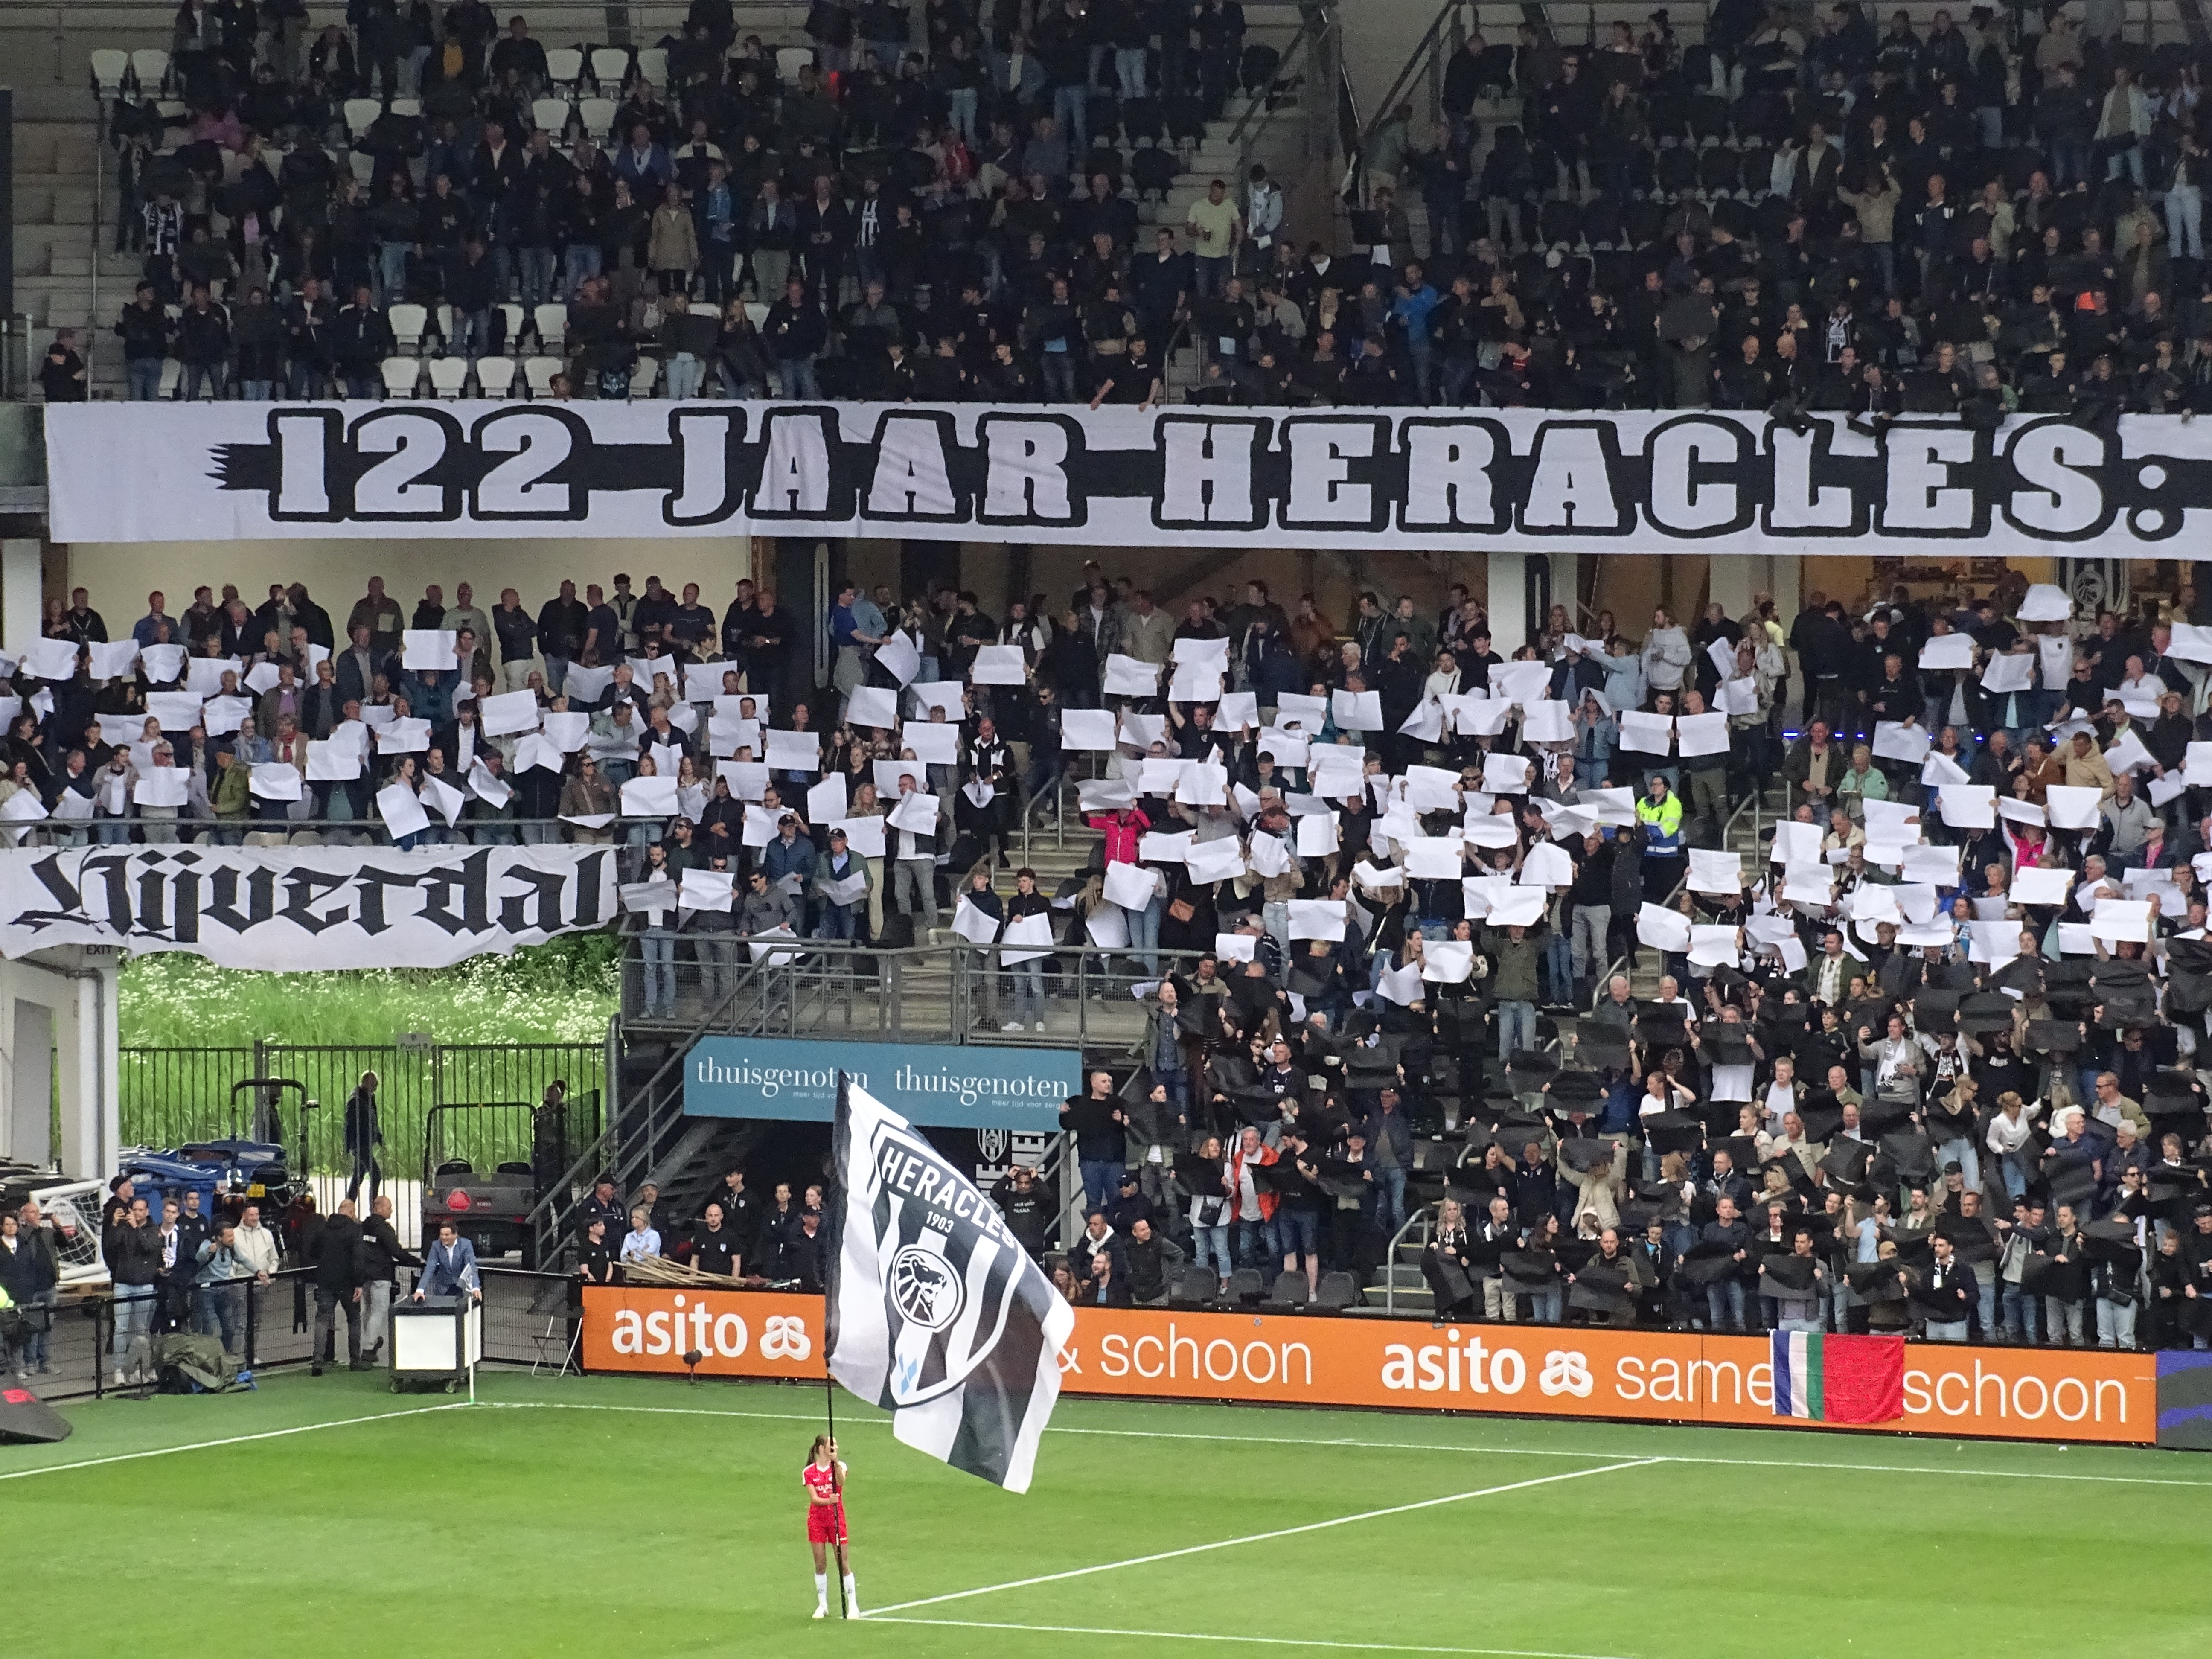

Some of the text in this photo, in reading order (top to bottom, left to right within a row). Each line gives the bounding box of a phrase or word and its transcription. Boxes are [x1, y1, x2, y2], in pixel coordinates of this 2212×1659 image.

[268, 405, 2185, 541] 122 JAAR HERACLES:
[8, 845, 614, 944] Nijverdal
[87, 944, 112, 955] EXIT
[894, 1064, 1069, 1106] thuisgenoten
[881, 1146, 1015, 1249] HERACLES
[926, 1211, 954, 1233] 1903
[612, 1294, 748, 1359] asito
[1100, 1322, 1312, 1385] schoon
[1381, 1328, 1527, 1394] asito
[1615, 1355, 2127, 1424] same schoon
